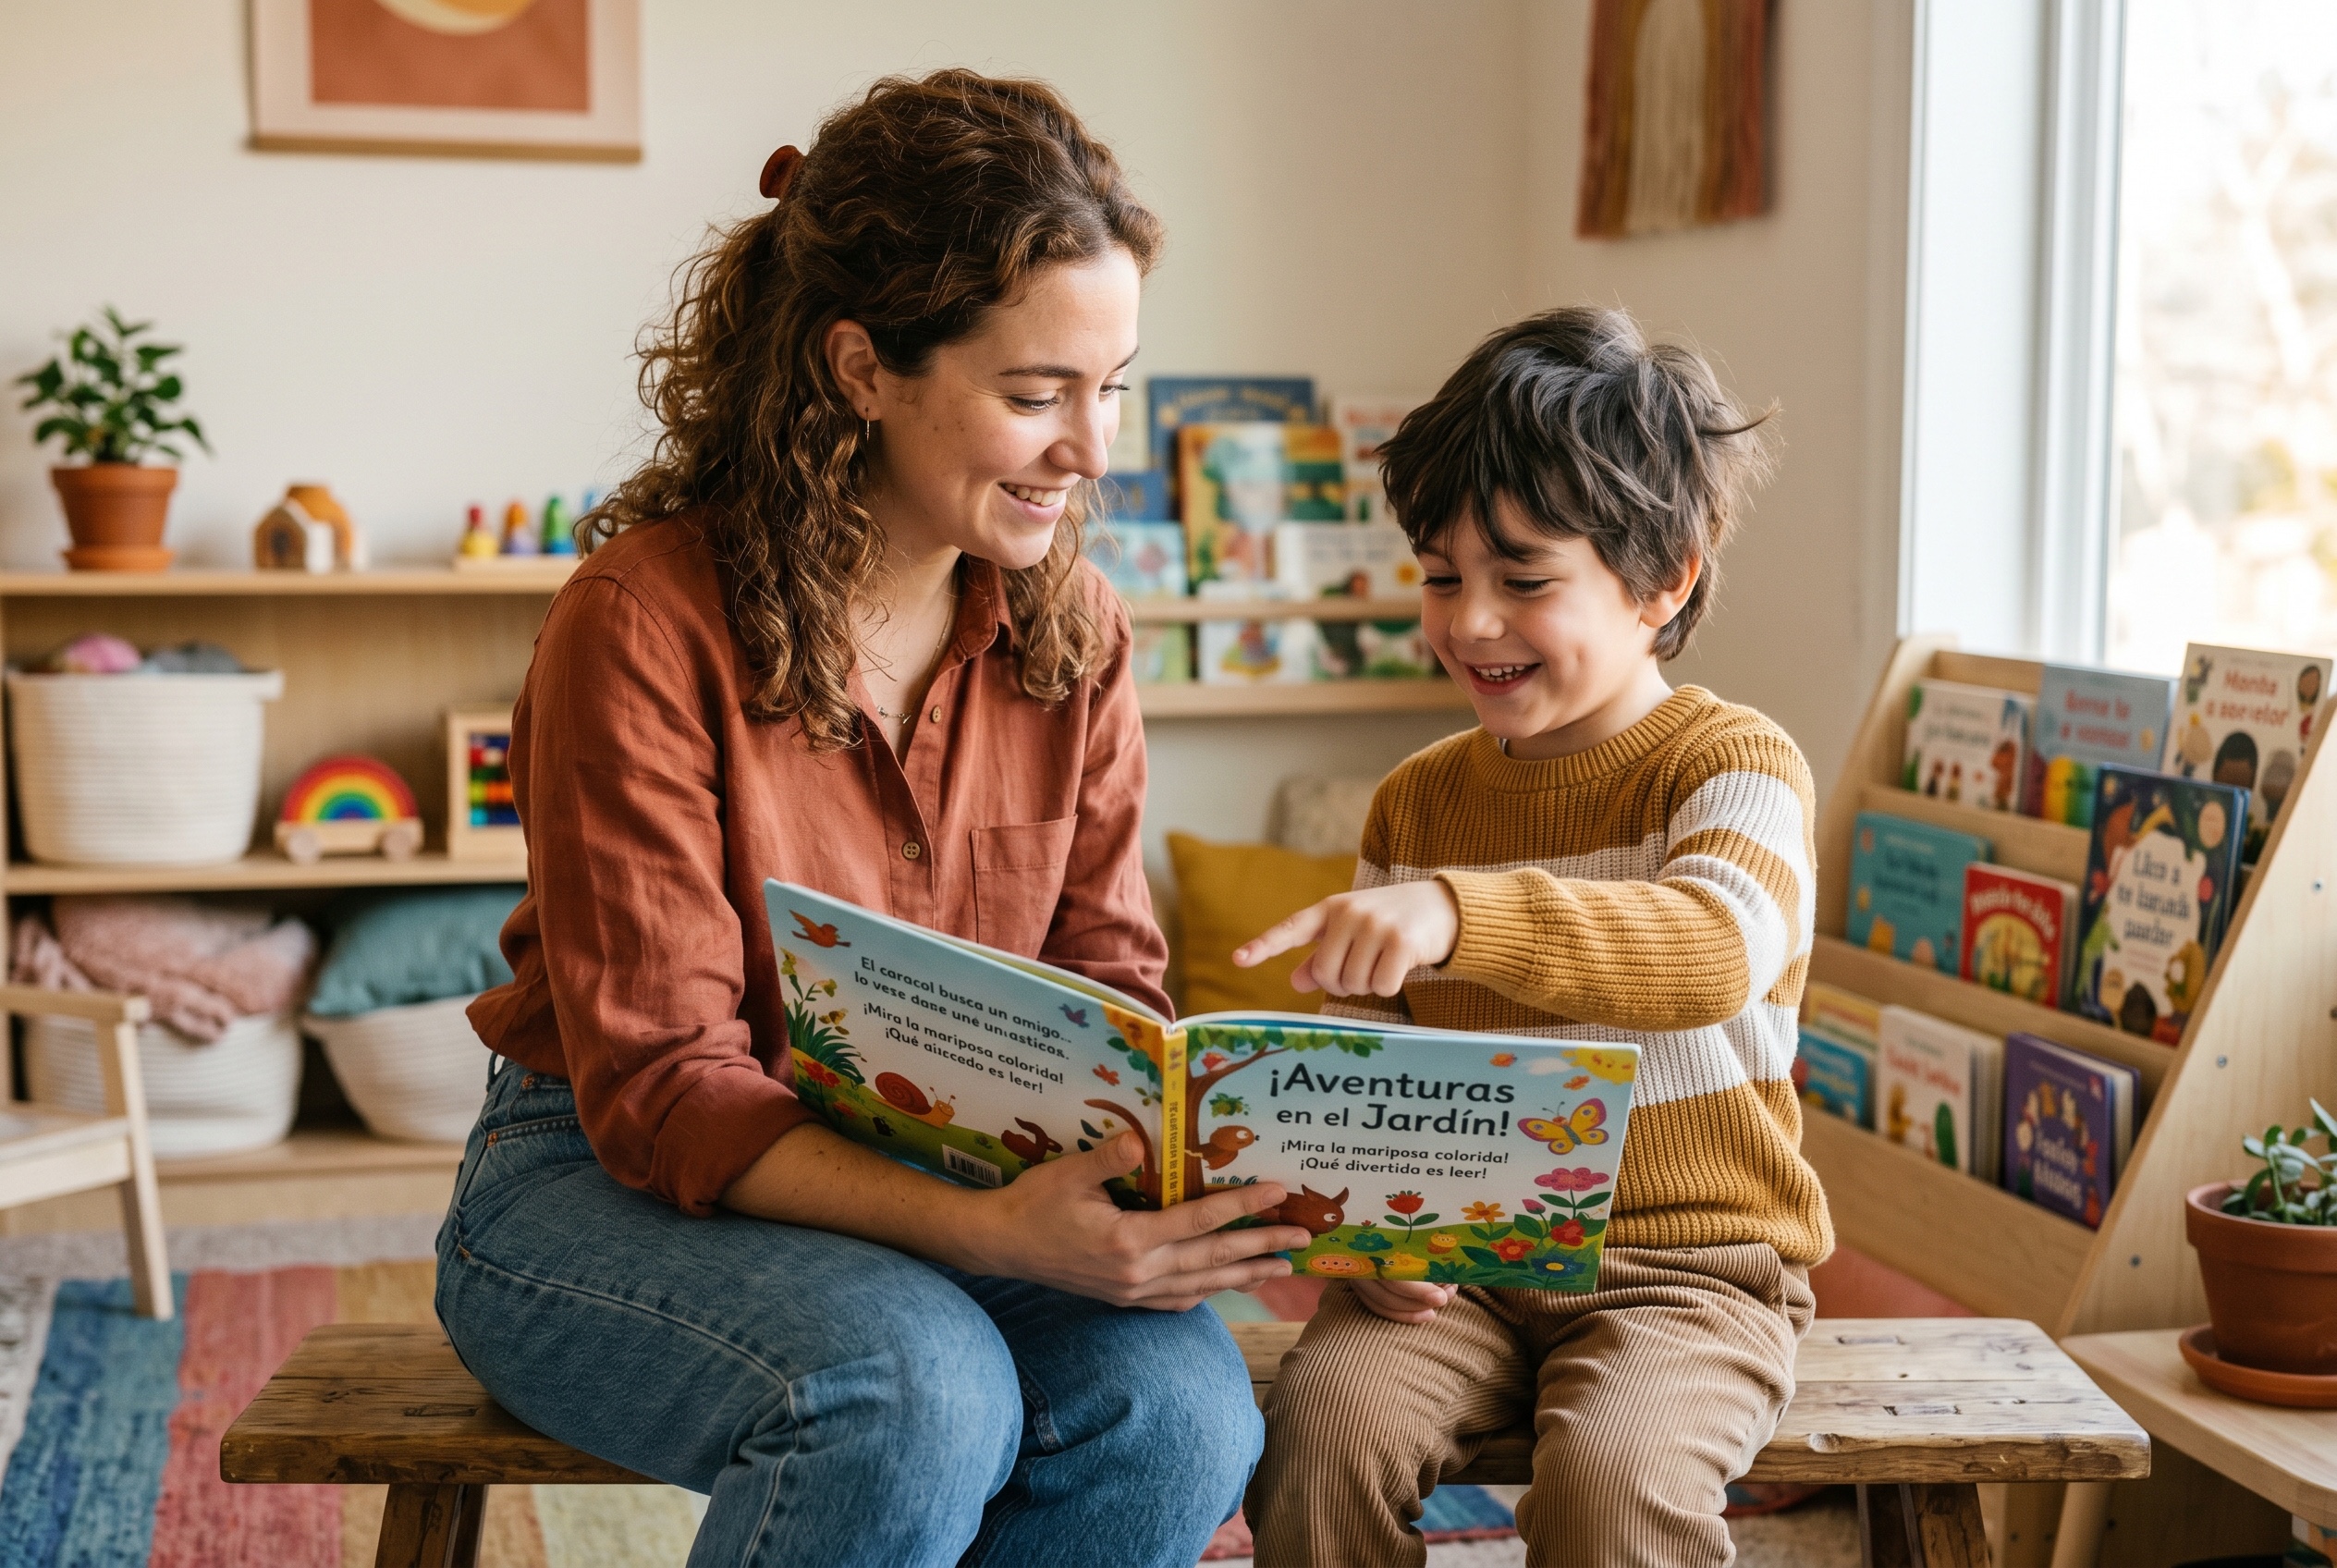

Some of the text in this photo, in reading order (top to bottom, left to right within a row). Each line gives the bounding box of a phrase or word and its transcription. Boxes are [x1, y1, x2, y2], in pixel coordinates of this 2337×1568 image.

[855, 971, 868, 986] lo
[862, 957, 875, 972] El
[880, 967, 934, 993] caracol
[939, 985, 983, 1011] busca
[988, 1007, 1008, 1020] un
[863, 1002, 1063, 1084] ¡Mira la mariposa colorida!
[886, 1027, 919, 1047] ¡Qué
[988, 1068, 1004, 1078] es
[1009, 1072, 1042, 1094] leer!
[1270, 1063, 1514, 1103] ¡Aventuras
[1277, 1103, 1510, 1136] en el Jardín!
[1281, 1140, 1509, 1163] ¡Mira la mariposa colorida!
[1300, 1158, 1487, 1179] ¡Qué divertida es leer!
